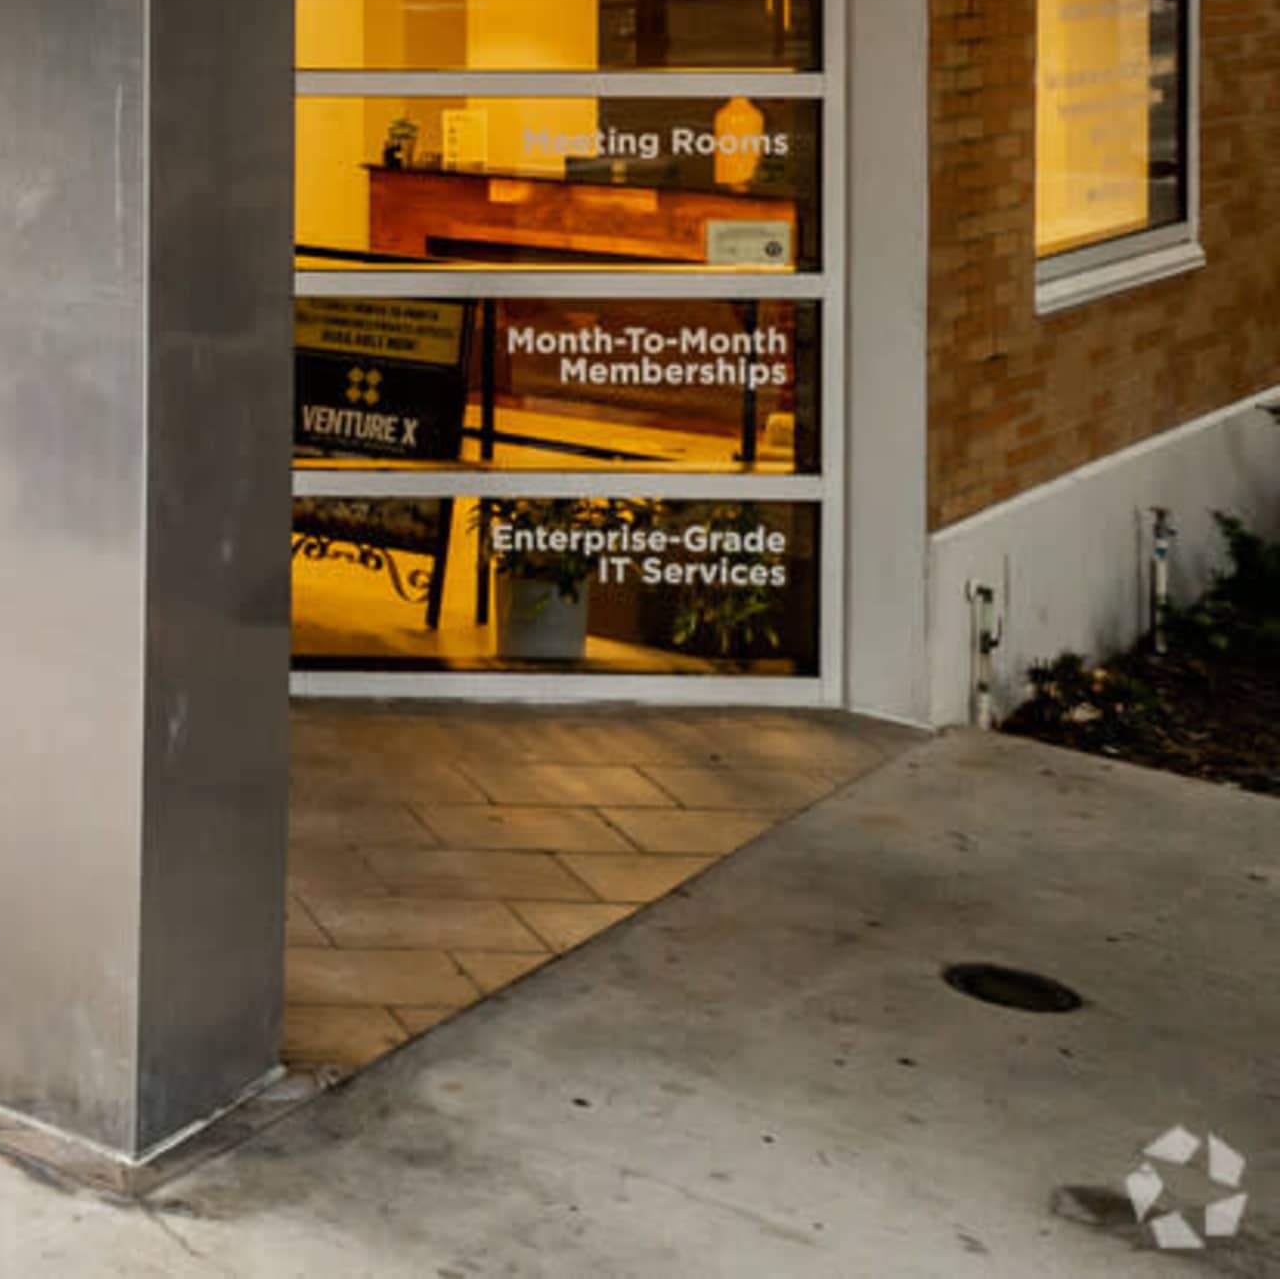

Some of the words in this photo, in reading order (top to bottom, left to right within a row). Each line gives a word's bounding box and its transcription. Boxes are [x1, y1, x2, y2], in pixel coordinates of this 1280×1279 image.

[524, 128, 659, 161] Meeting
[672, 129, 789, 156] Rooms
[507, 326, 788, 355] Month-To-Month
[560, 358, 788, 388] Memberships
[302, 405, 400, 444] VENTURE
[402, 417, 419, 448] X
[493, 524, 786, 559] Enterprise-Grade
[599, 557, 630, 585] IT
[642, 557, 786, 587] Services
